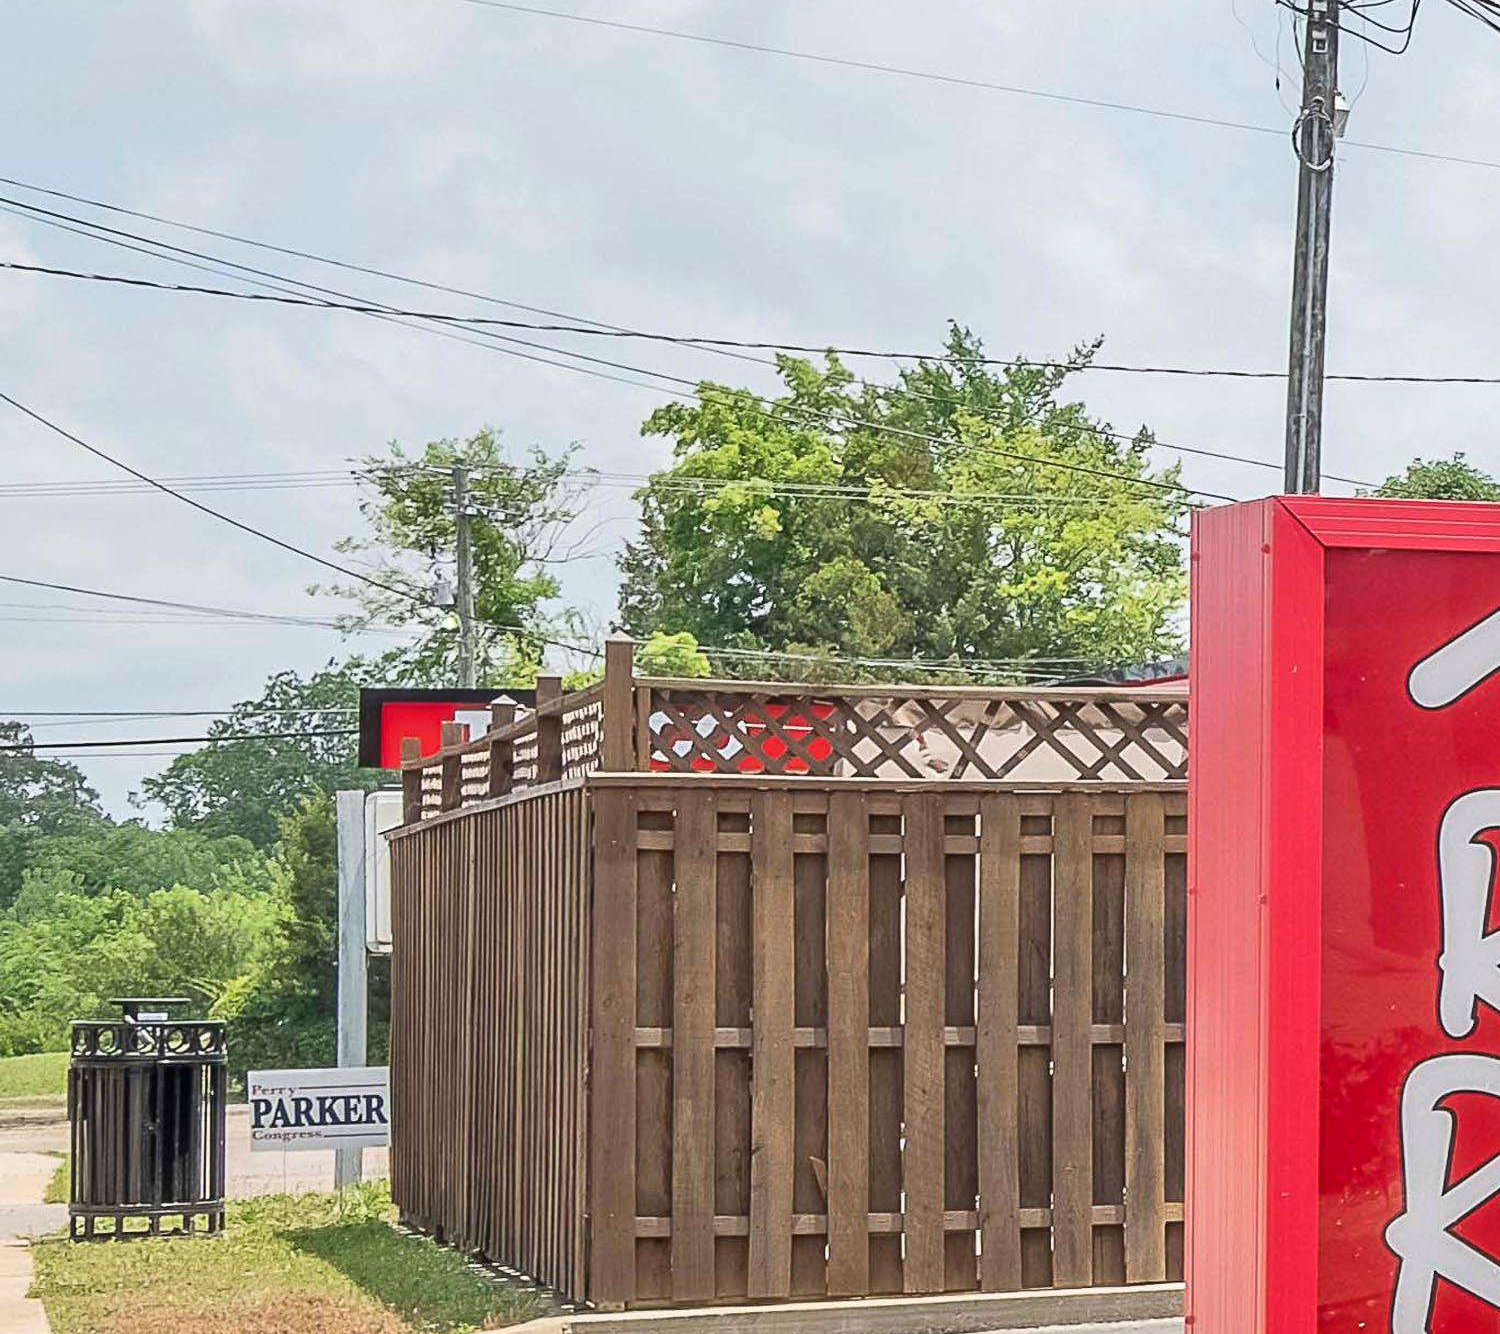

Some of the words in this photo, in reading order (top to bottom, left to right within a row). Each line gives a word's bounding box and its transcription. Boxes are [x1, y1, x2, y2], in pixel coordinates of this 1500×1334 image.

[252, 1085, 297, 1097] Perry
[250, 1094, 388, 1129] PARKER
[252, 1129, 323, 1142] Congress
